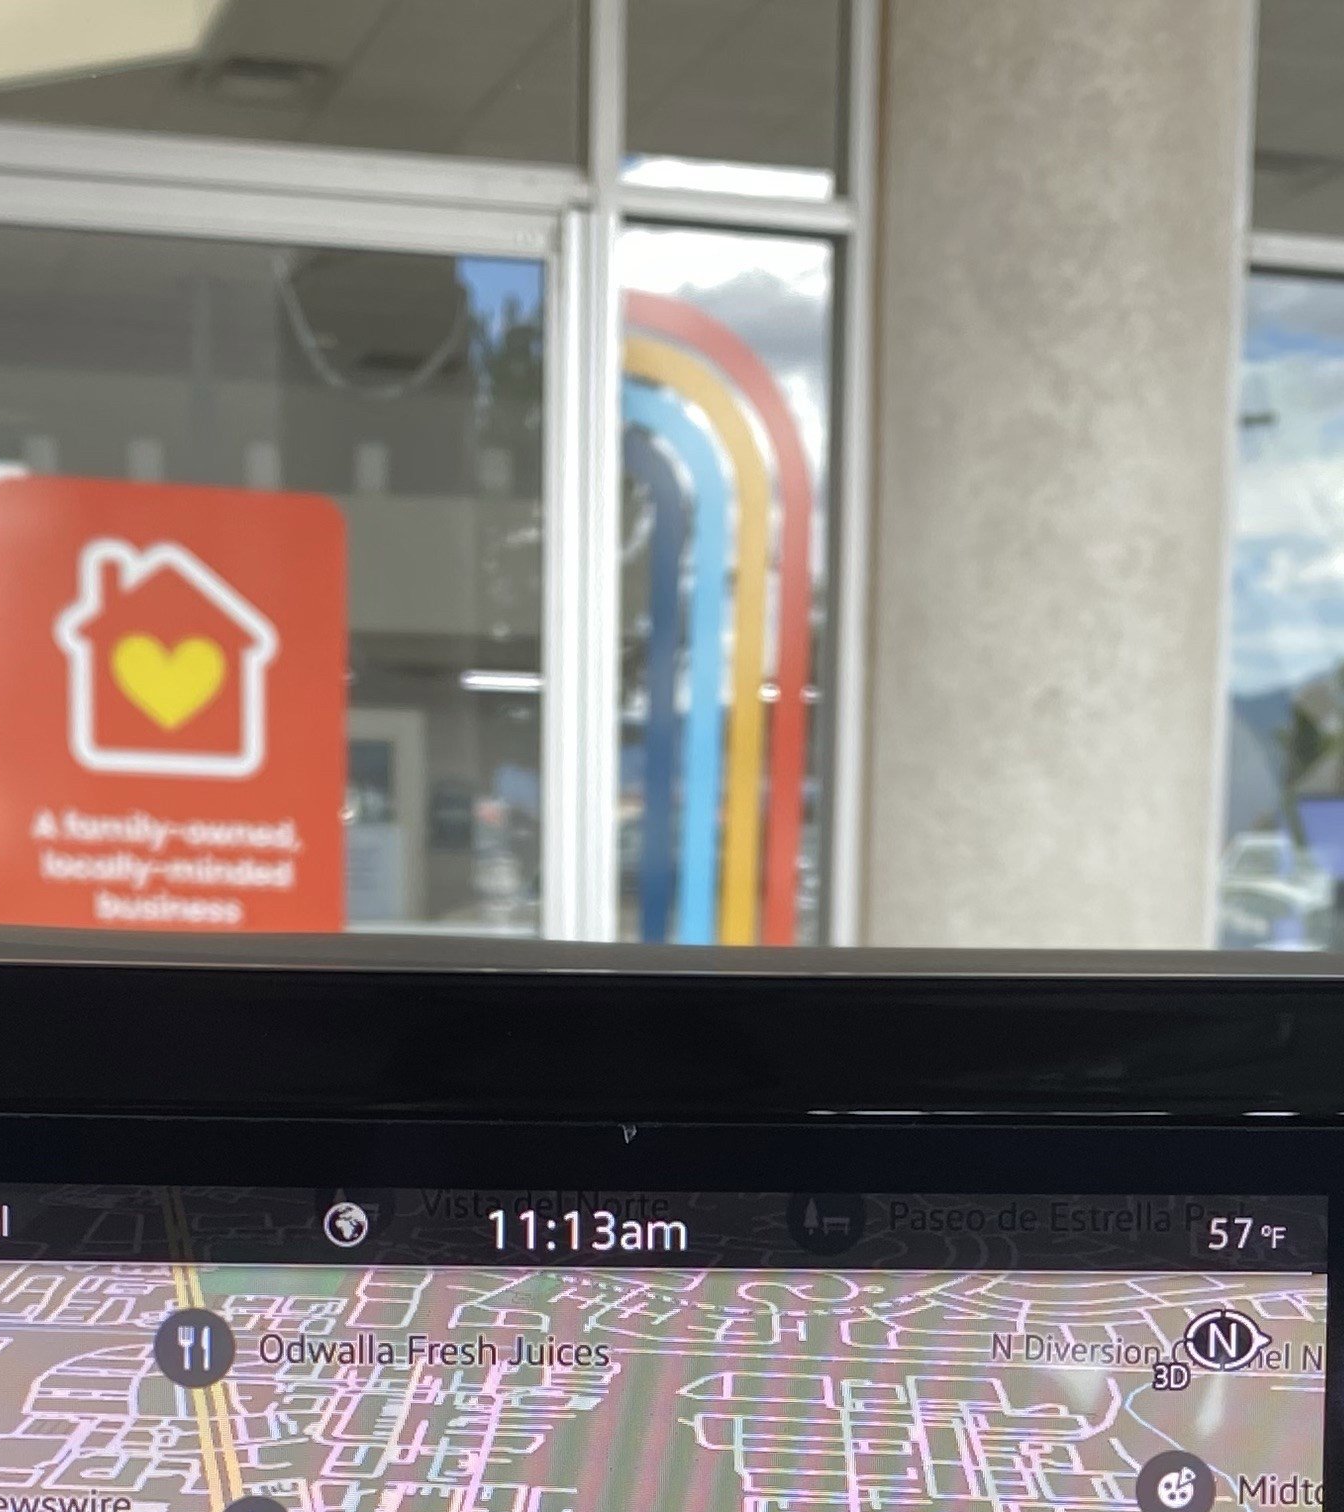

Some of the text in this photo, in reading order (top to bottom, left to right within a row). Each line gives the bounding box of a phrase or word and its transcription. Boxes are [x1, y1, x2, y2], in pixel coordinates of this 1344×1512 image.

[33, 809, 57, 839] A
[40, 849, 294, 890] locally-minded
[94, 890, 243, 924] business
[490, 1209, 686, 1252] 11:13am
[259, 1333, 612, 1370] Odwalla Fresh Juices
[992, 1333, 1012, 1360] N
[1024, 1332, 1160, 1364] Diversion
[1209, 1322, 1237, 1359] N
[1154, 1364, 1189, 1390] 3D
